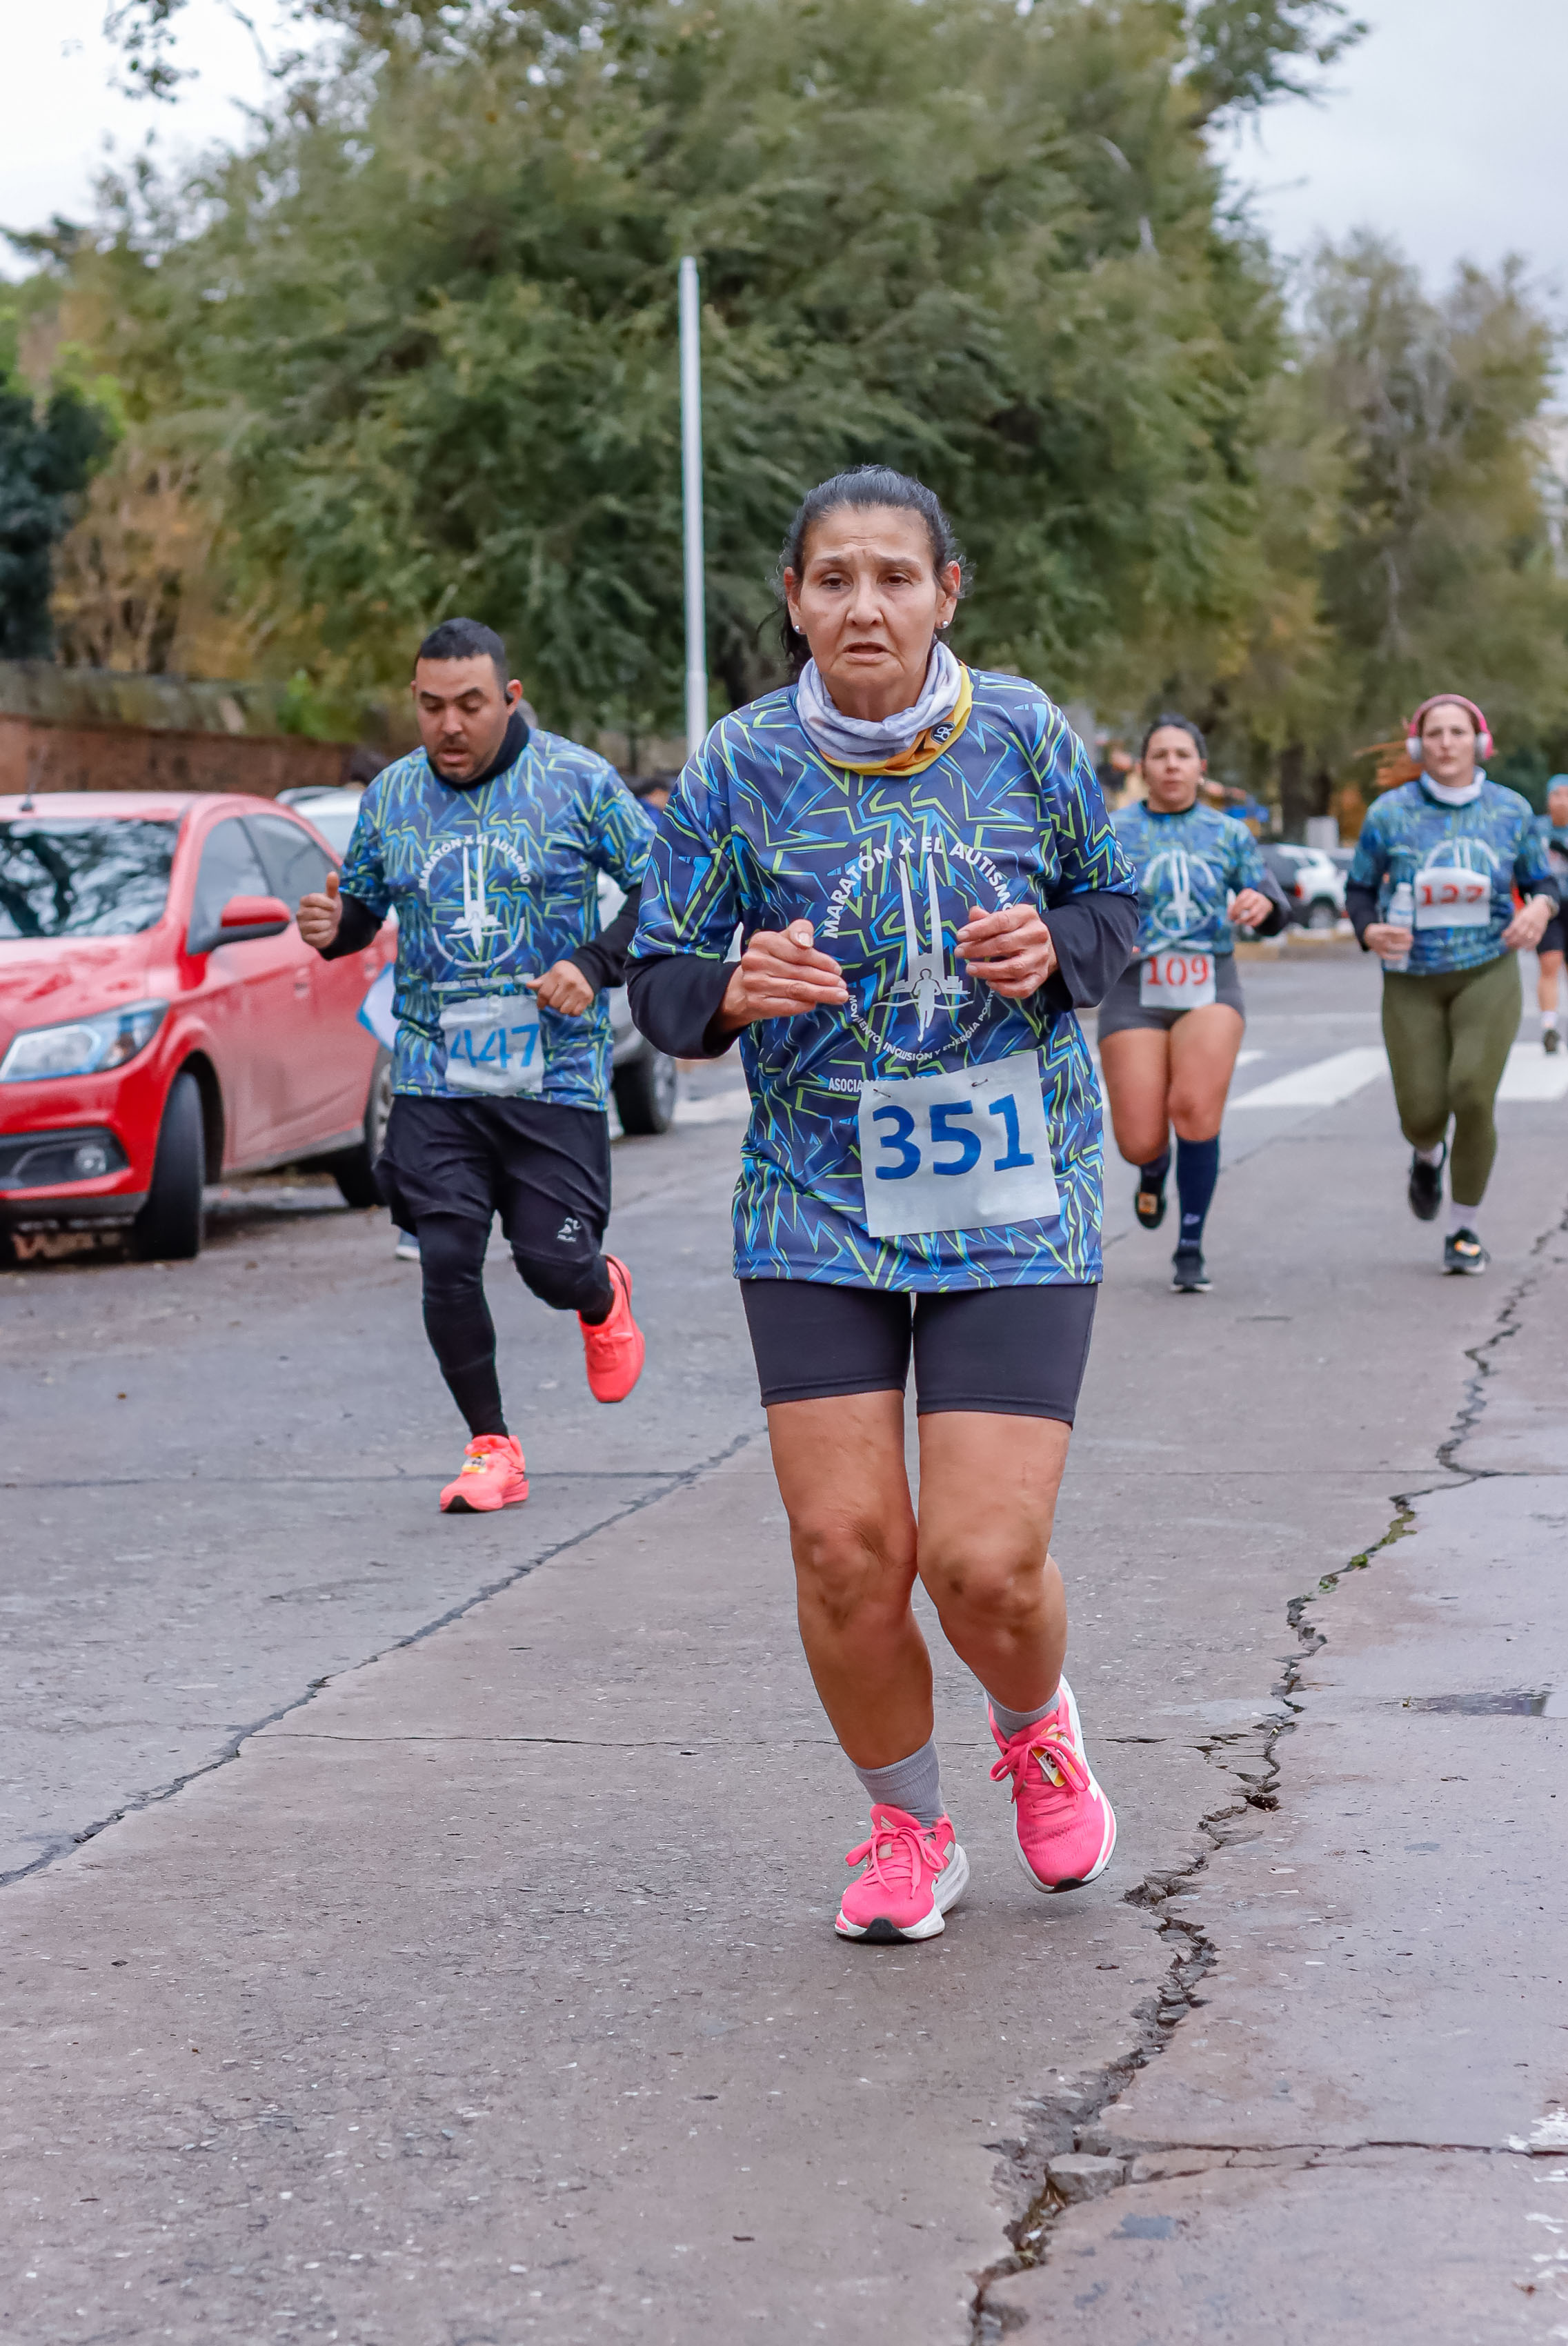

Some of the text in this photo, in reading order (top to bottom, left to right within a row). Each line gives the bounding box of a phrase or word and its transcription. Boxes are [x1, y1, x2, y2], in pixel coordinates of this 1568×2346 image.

[823, 844, 893, 939] MARATÓN
[898, 837, 915, 855] X
[922, 836, 943, 854] EL
[1147, 955, 1209, 986] 109
[450, 1023, 539, 1068] 447
[873, 1093, 1035, 1180] 351
